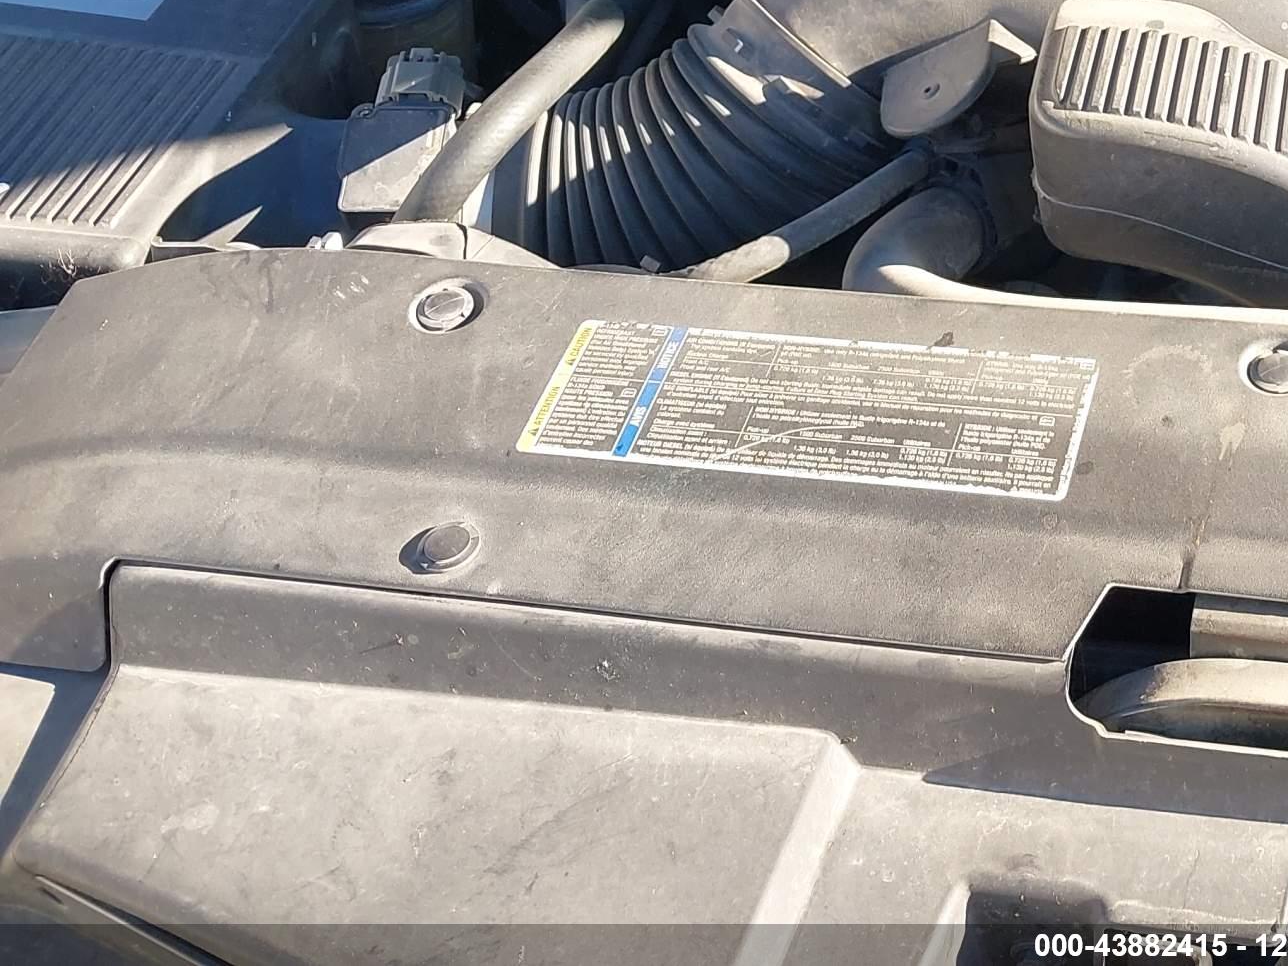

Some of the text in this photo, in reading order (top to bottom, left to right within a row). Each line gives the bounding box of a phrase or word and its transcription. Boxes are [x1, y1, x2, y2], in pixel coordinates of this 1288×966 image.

[573, 326, 592, 353] CAUTION
[657, 341, 680, 370] NOTICE
[534, 386, 560, 427] ATTENTION
[629, 406, 647, 427] AVIS
